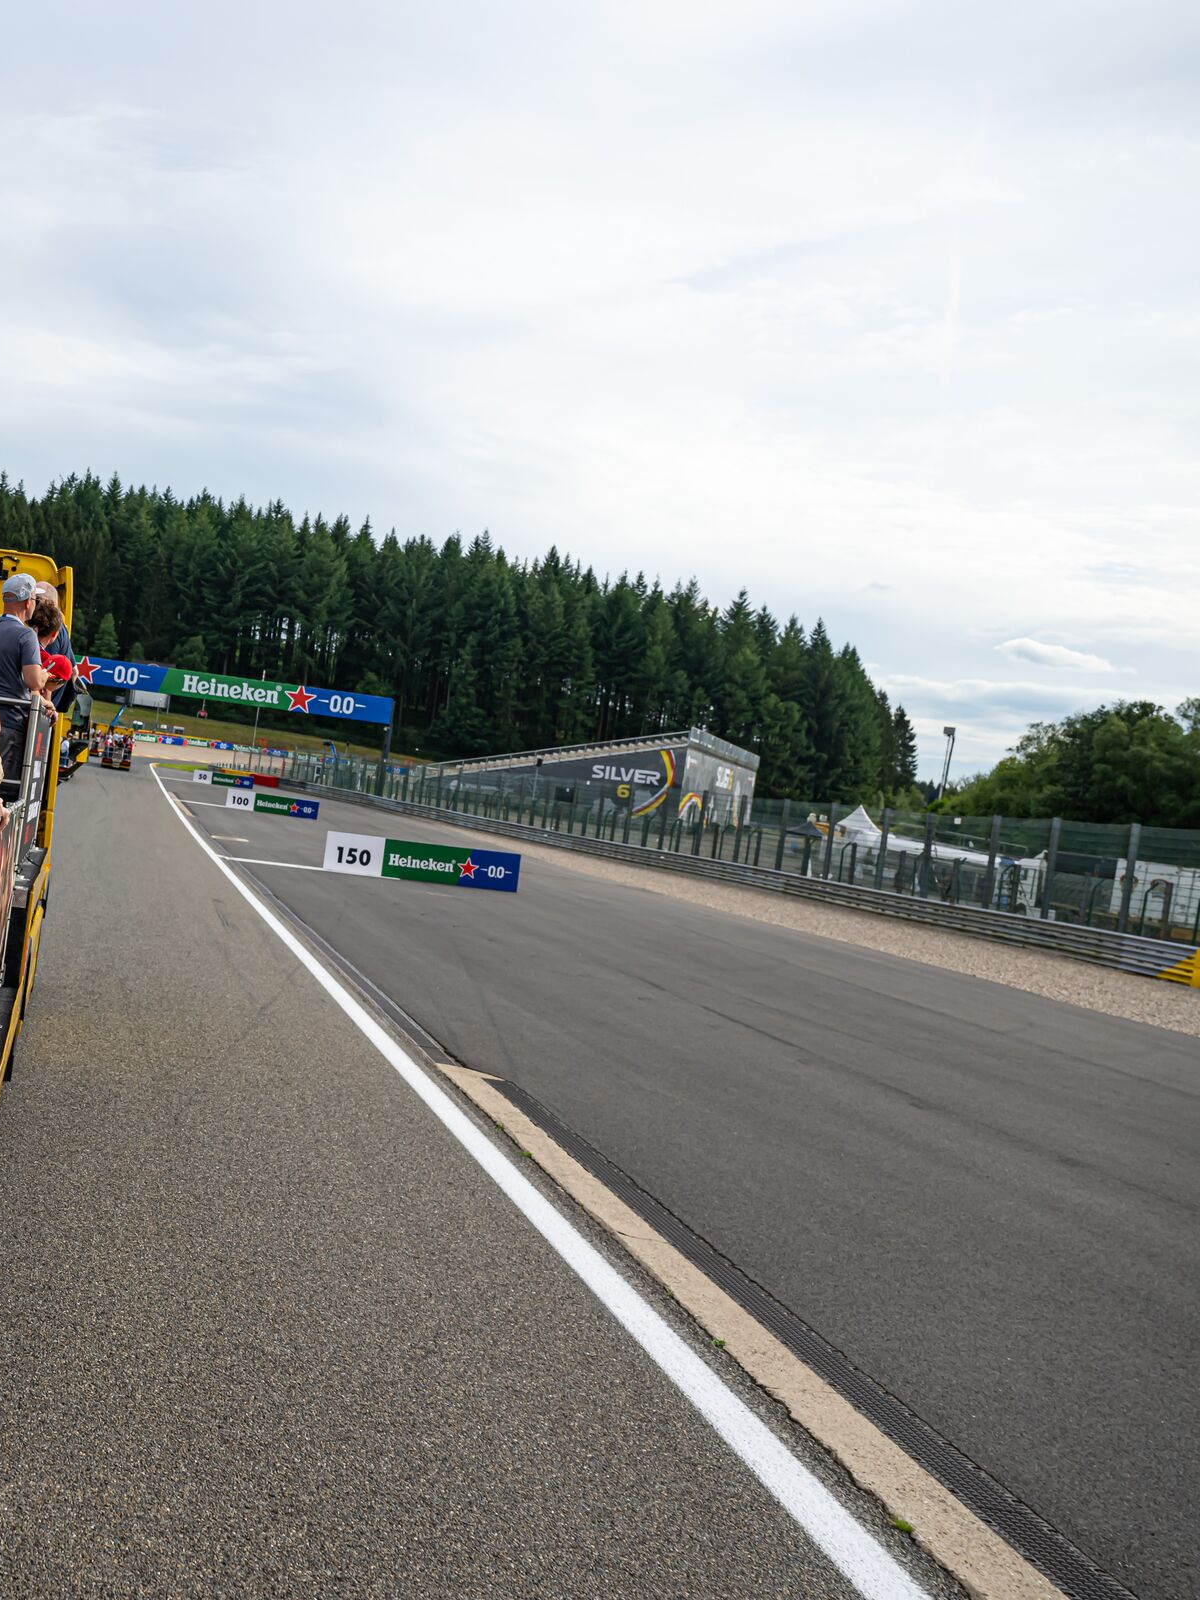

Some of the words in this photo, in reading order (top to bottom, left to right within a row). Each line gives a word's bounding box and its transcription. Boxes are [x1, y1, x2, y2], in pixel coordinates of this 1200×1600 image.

[181, 674, 280, 705] Heineken
[198, 773, 208, 781] 50
[591, 764, 661, 787] SILVER
[616, 784, 631, 799] 6
[232, 795, 249, 806] 100
[256, 799, 288, 811] Heineken
[336, 846, 371, 867] 150
[388, 853, 454, 873] Heineken
